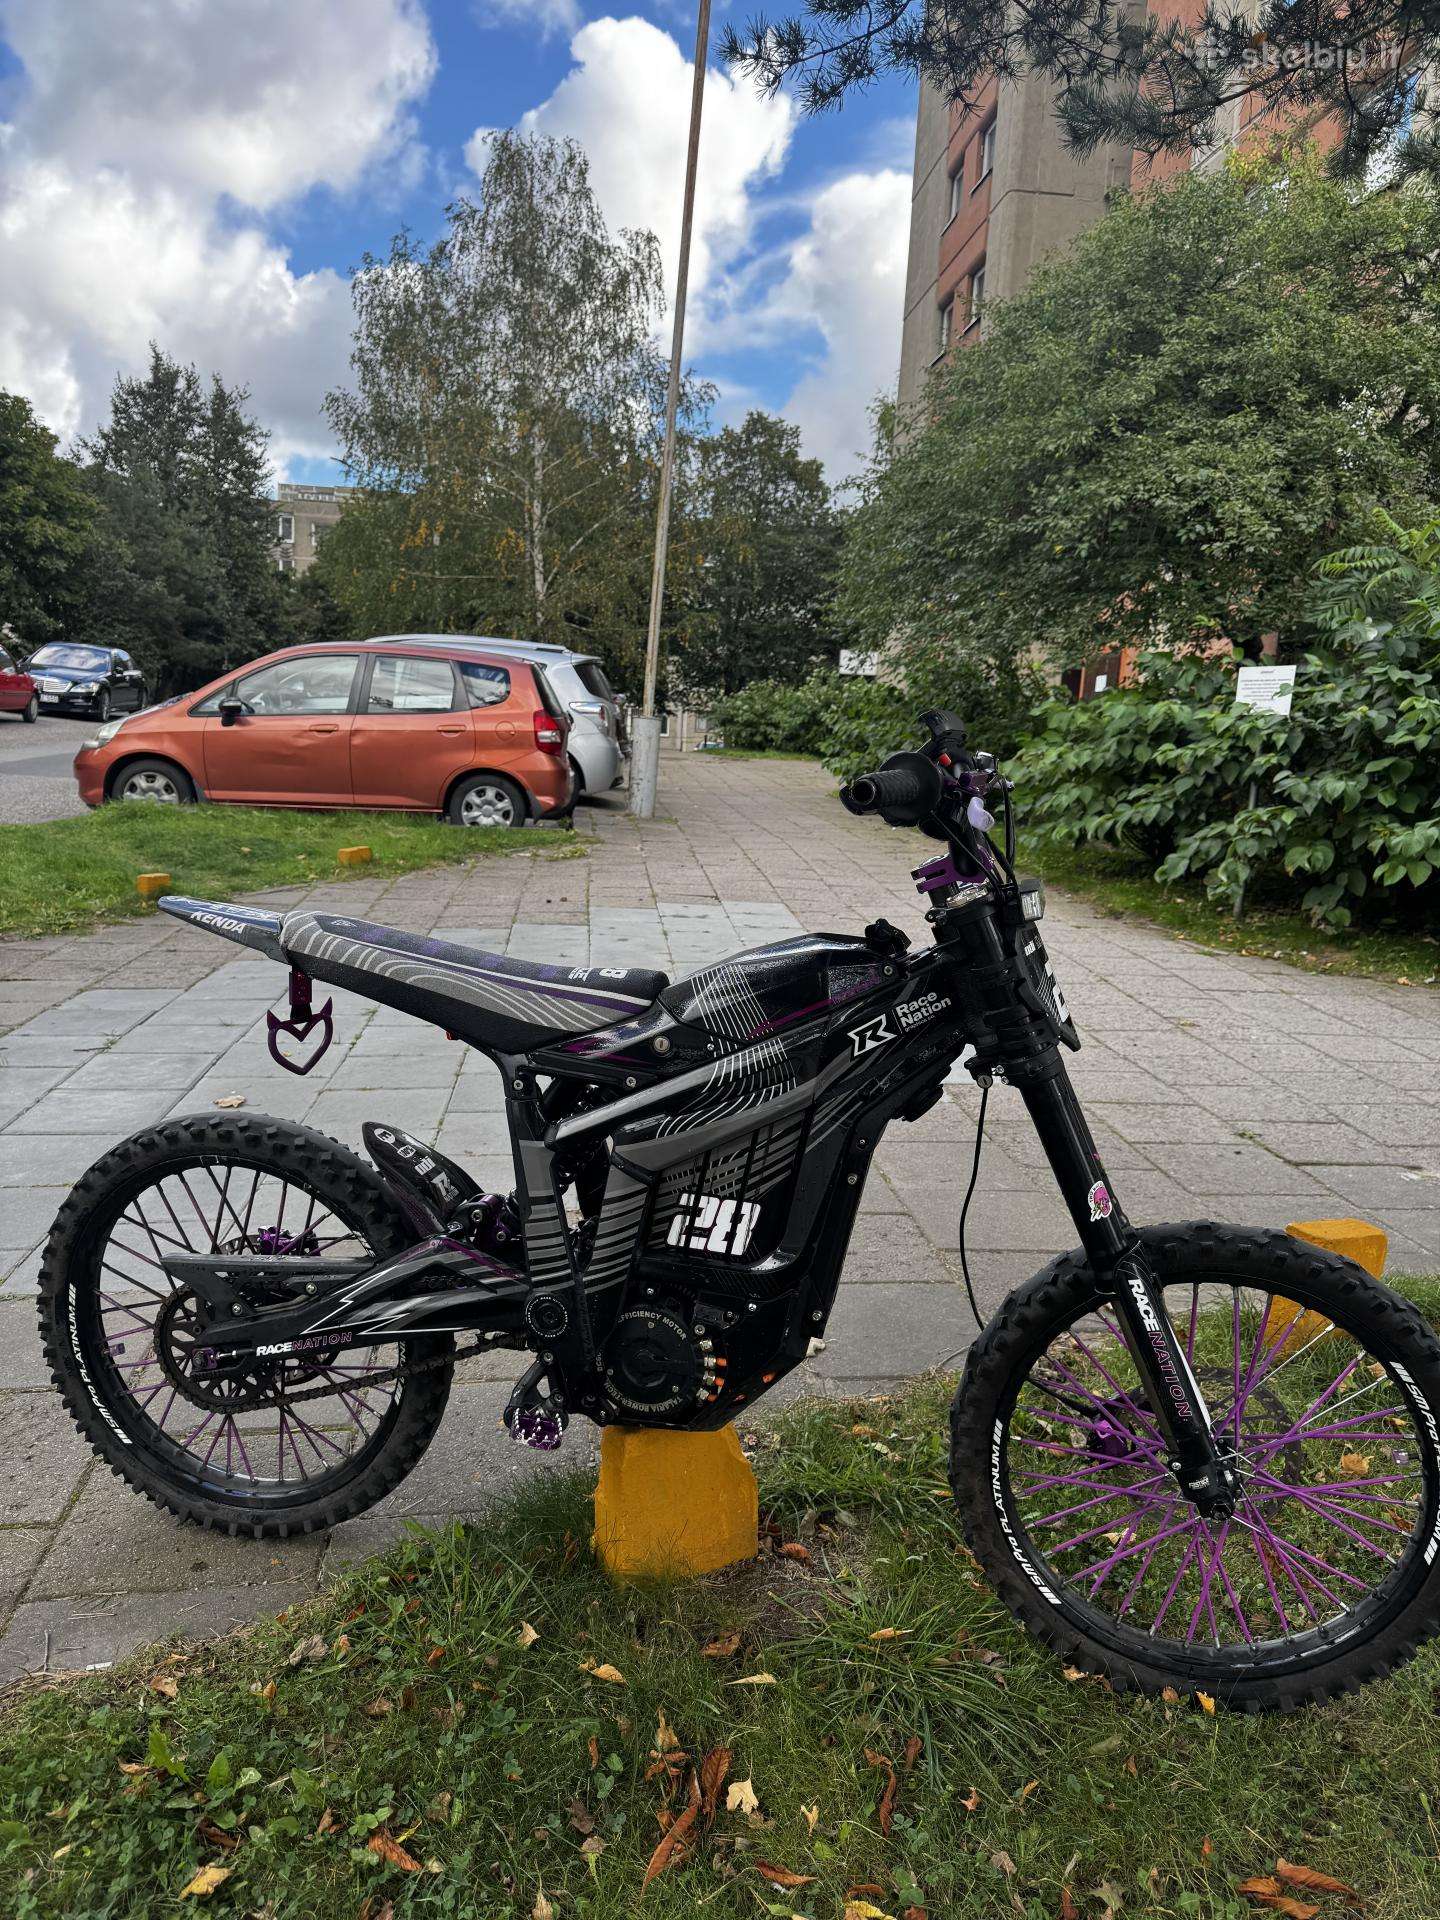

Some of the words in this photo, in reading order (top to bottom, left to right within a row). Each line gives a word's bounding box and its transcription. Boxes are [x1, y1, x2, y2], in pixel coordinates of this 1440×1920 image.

[189, 911, 248, 935] KENDA
[895, 992, 938, 1017] Race
[899, 997, 952, 1028] Nation
[666, 1193, 761, 1256] 28
[662, 1317, 687, 1340] MOTOR
[69, 1306, 91, 1383] PLATINUM
[653, 1396, 684, 1412] TALARIA
[991, 1445, 1013, 1534] PLATINUM
